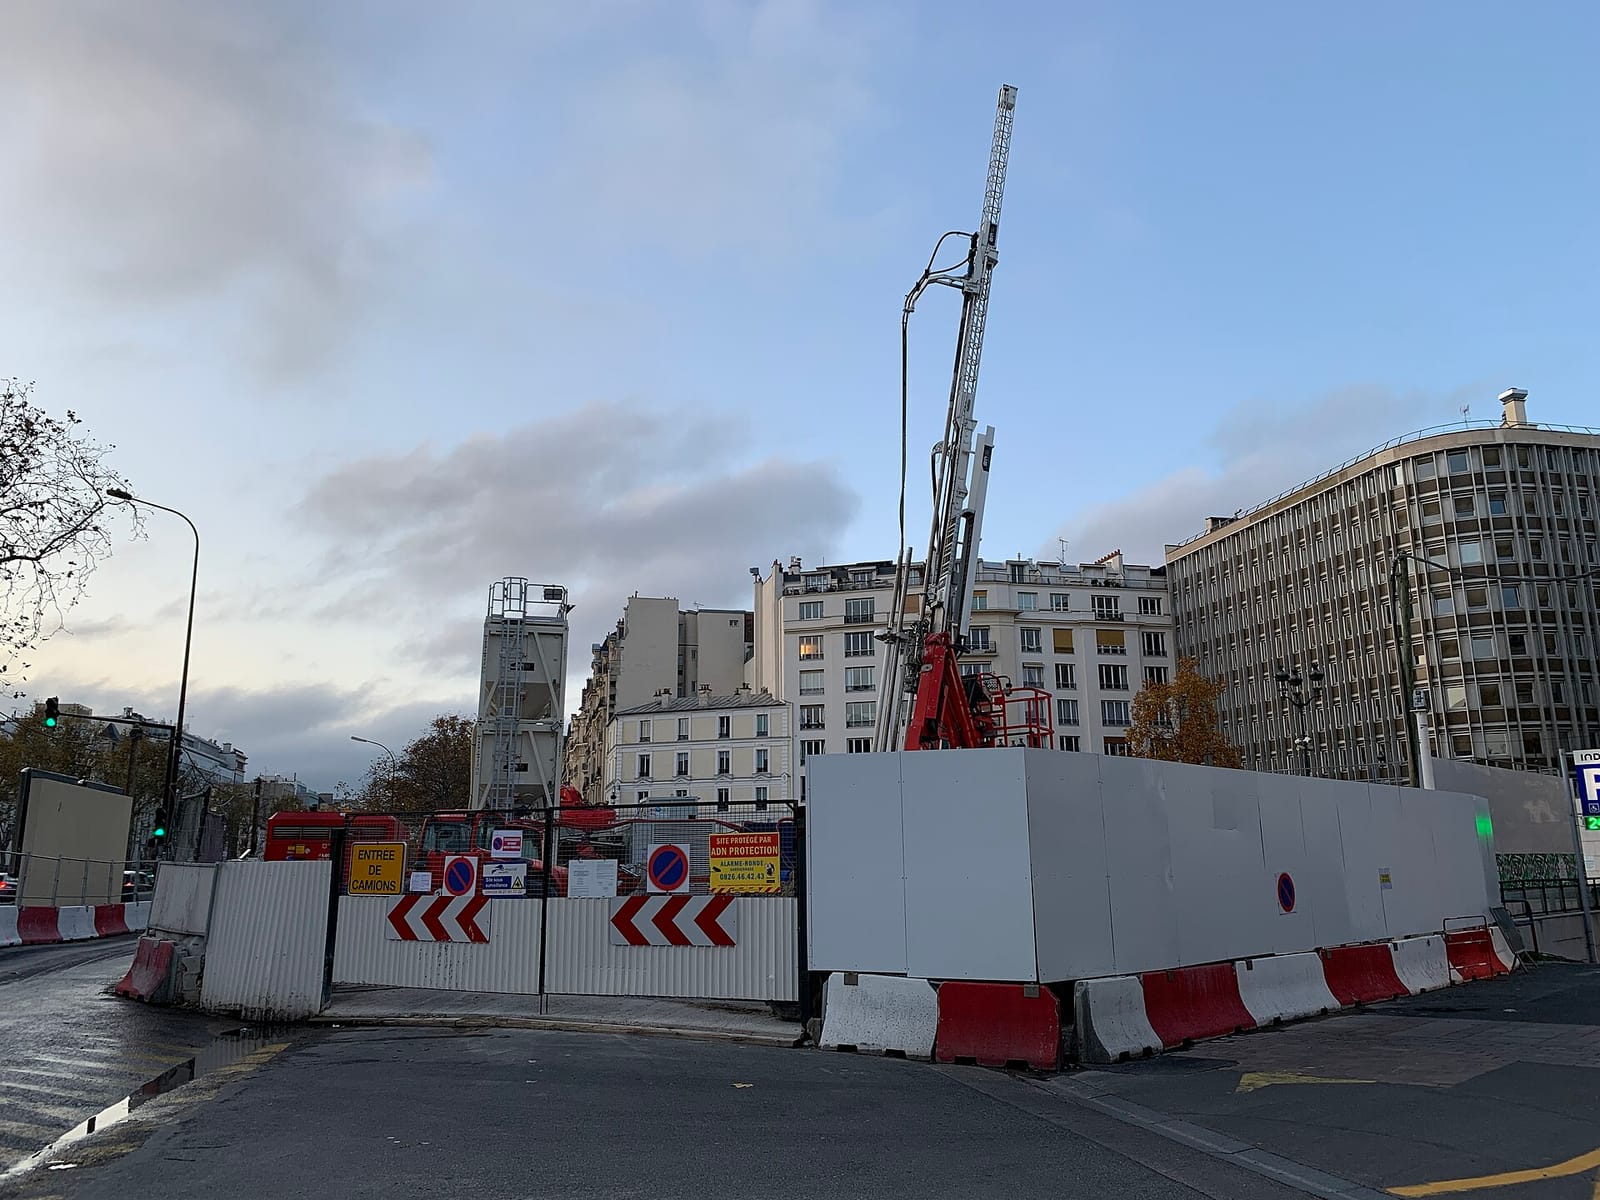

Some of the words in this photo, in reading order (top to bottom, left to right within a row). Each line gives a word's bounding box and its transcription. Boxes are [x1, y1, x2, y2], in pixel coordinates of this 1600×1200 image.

[716, 837, 729, 845] SITE
[358, 847, 396, 861] ENTRÉE
[711, 847, 727, 856] ADN
[729, 845, 778, 855] PROTECTION
[368, 864, 382, 876] DE
[351, 879, 397, 892] CAMIONS
